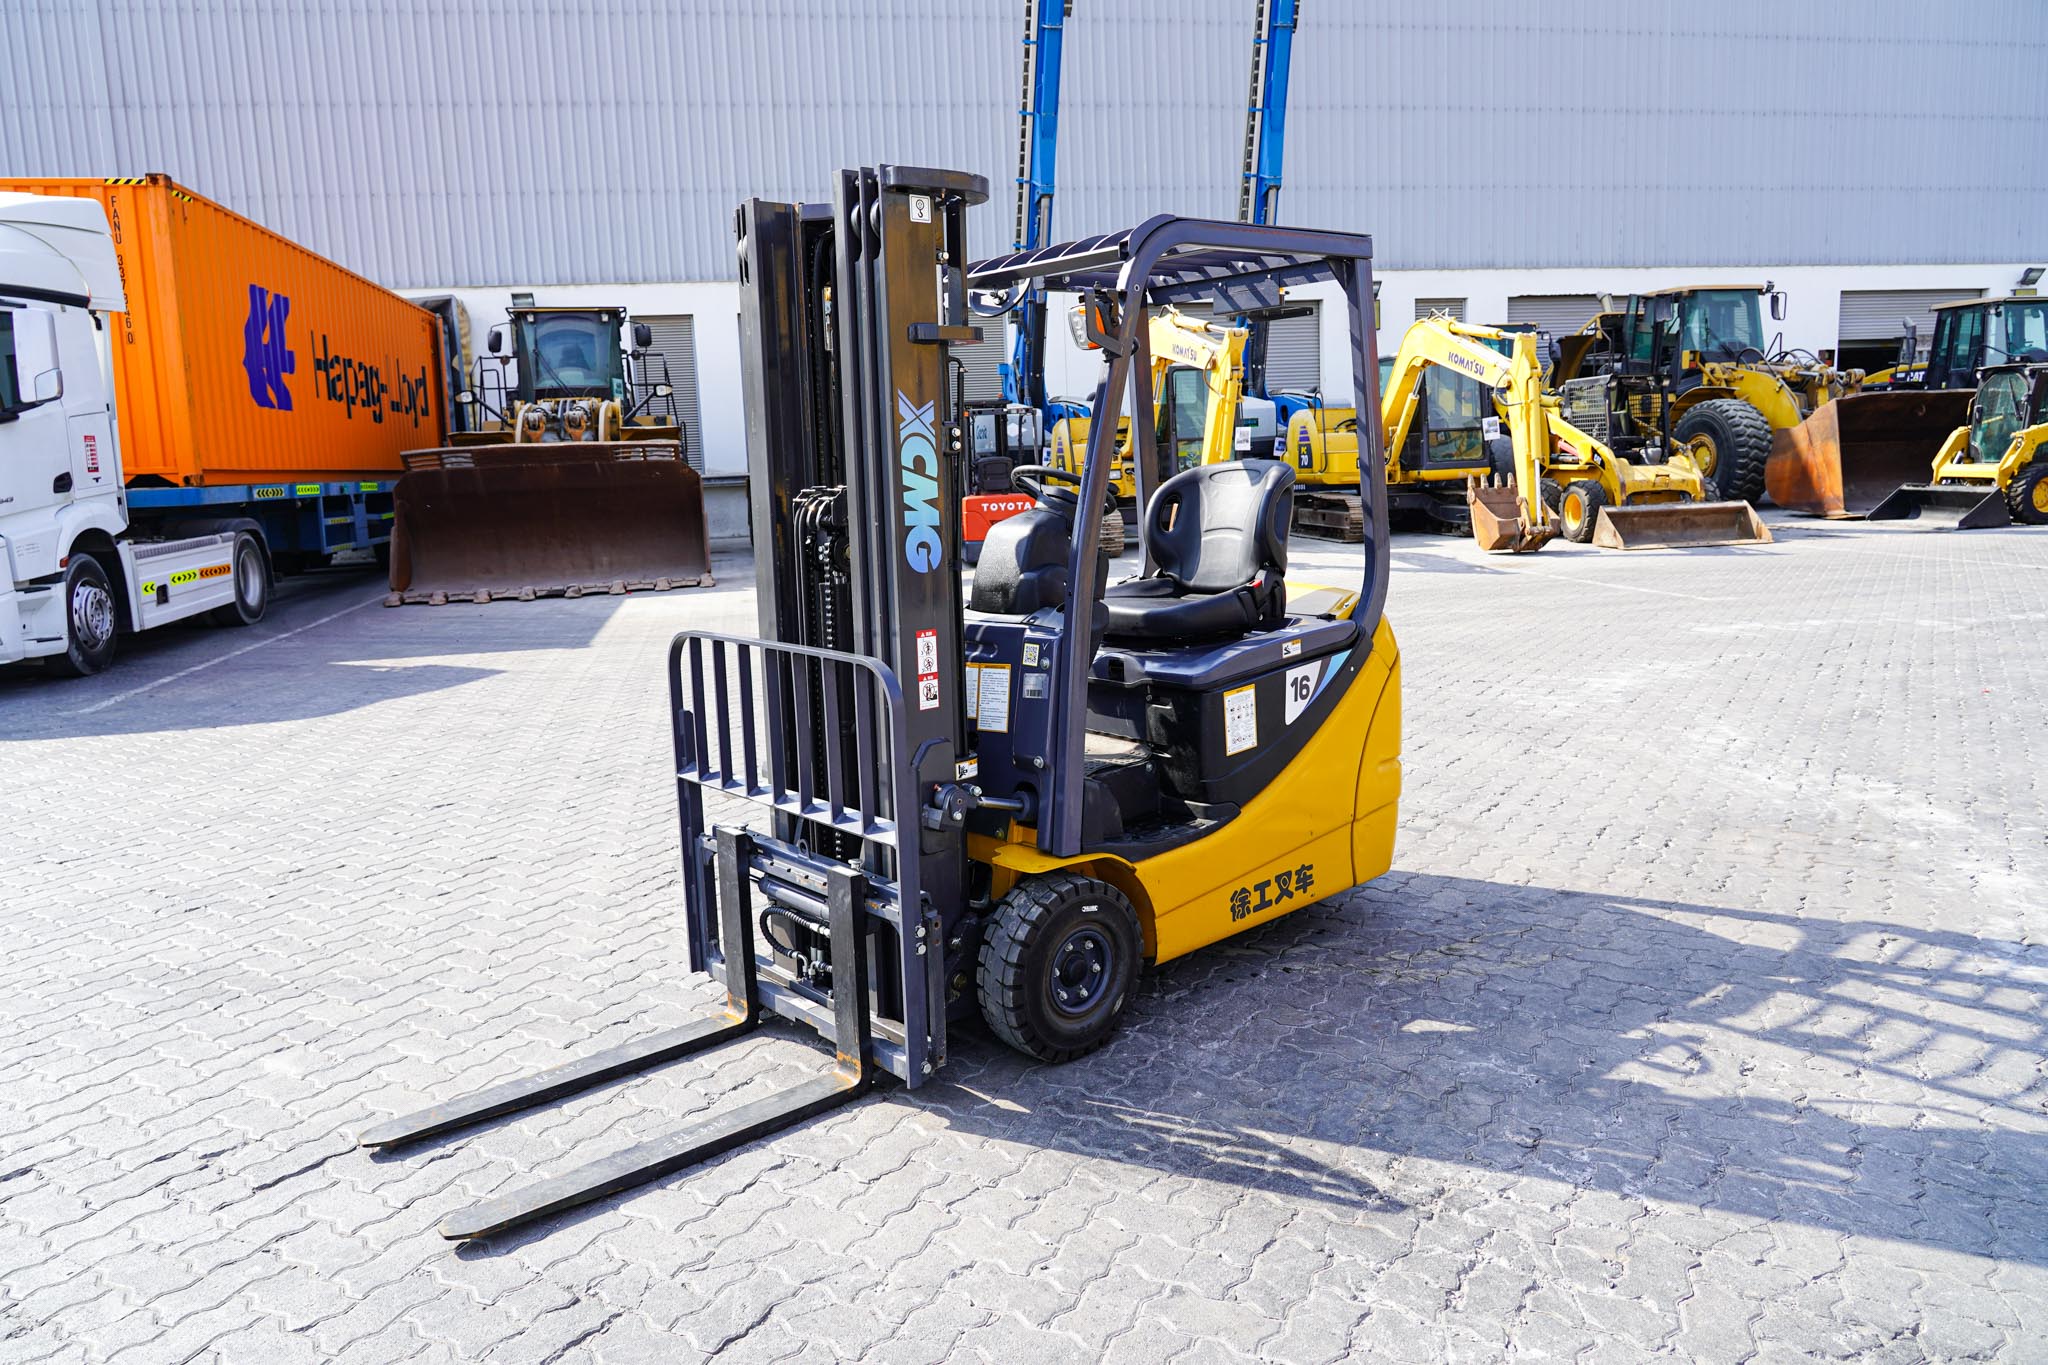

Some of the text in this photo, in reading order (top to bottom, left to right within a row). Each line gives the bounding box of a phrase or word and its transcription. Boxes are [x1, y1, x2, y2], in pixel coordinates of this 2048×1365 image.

[111, 196, 122, 244] FANU
[1172, 343, 1198, 362] KOMATSU
[1448, 351, 1485, 377] KOMATSU
[898, 388, 942, 574] XCMG
[981, 501, 1032, 511] TOYOTA
[1290, 675, 1311, 703] 16
[1229, 863, 1315, 923] 徐工叉车
